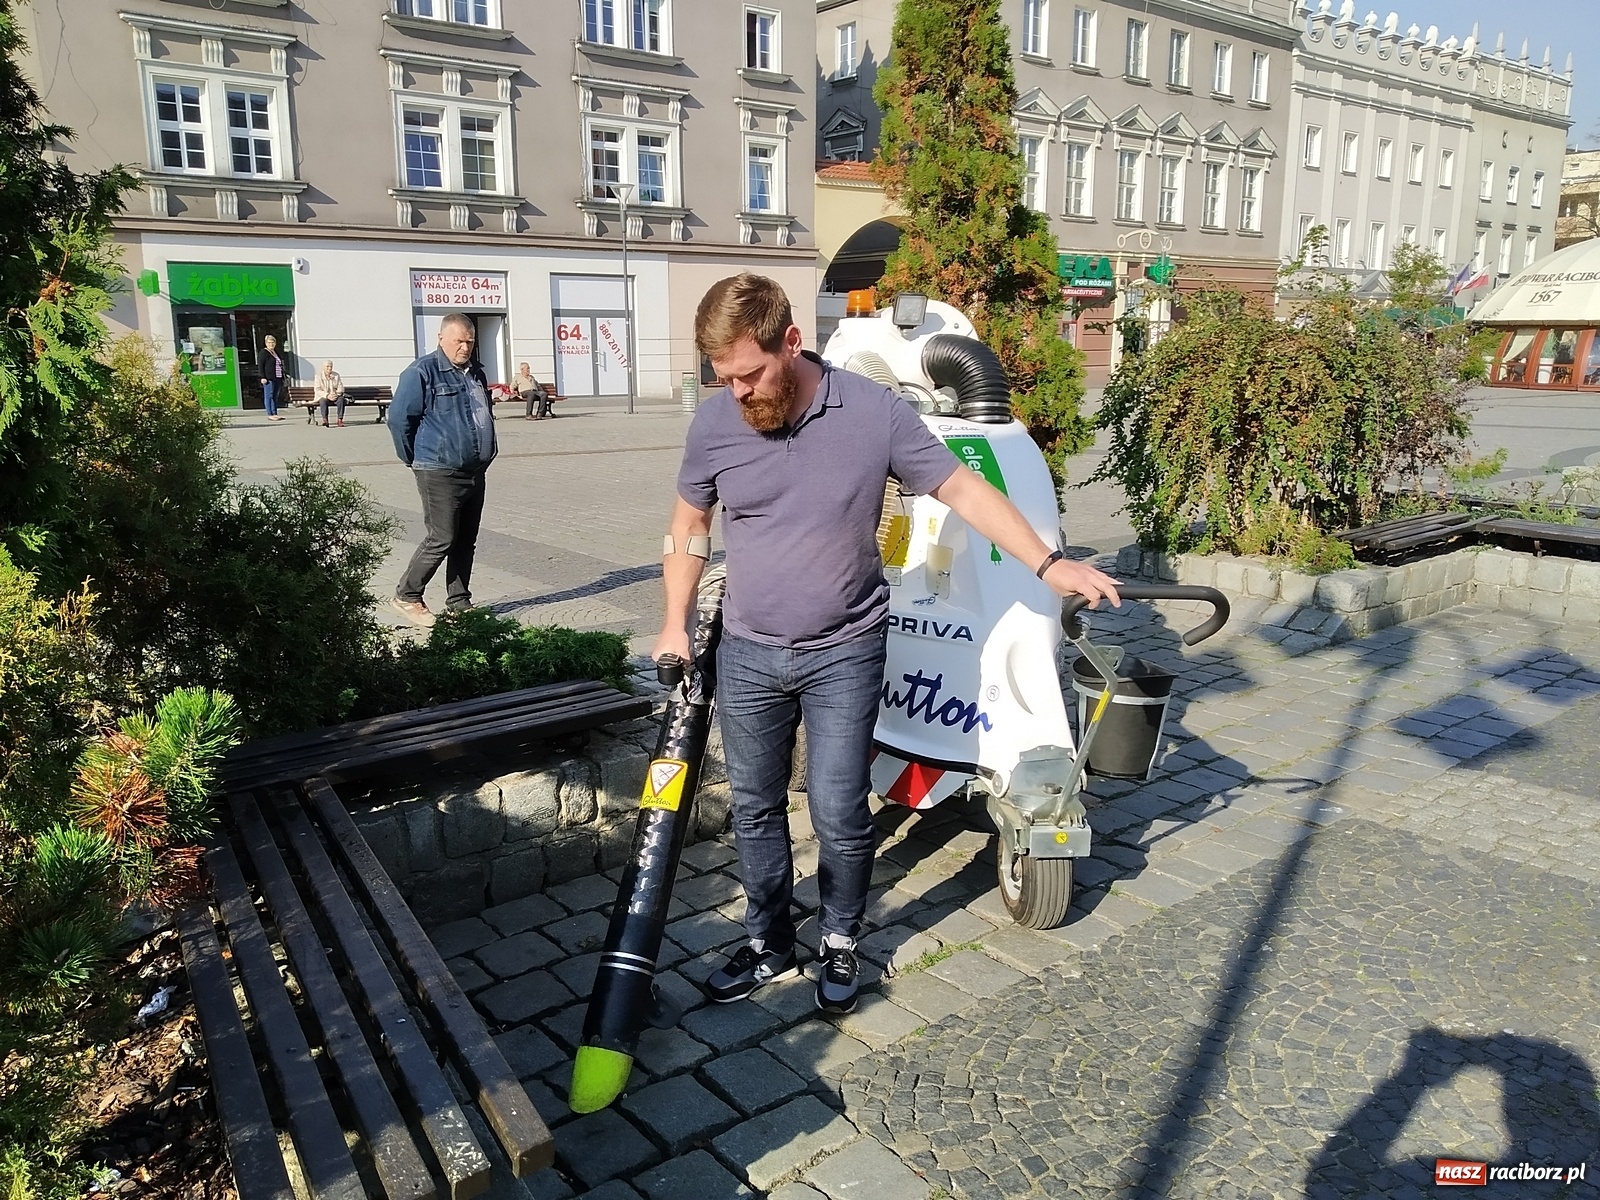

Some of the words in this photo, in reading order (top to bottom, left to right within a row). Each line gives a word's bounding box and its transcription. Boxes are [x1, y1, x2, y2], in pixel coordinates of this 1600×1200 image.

[413, 274, 449, 282] LOKAL
[1058, 254, 1113, 279] EKA
[187, 272, 279, 297] żabka
[1528, 290, 1562, 304] 1567
[427, 293, 450, 304] 880
[454, 294, 475, 304] 201
[480, 295, 502, 305] 117
[599, 323, 612, 340] 880
[608, 338, 621, 355] 201
[888, 614, 974, 642] PRIVA
[880, 669, 993, 734] utton
